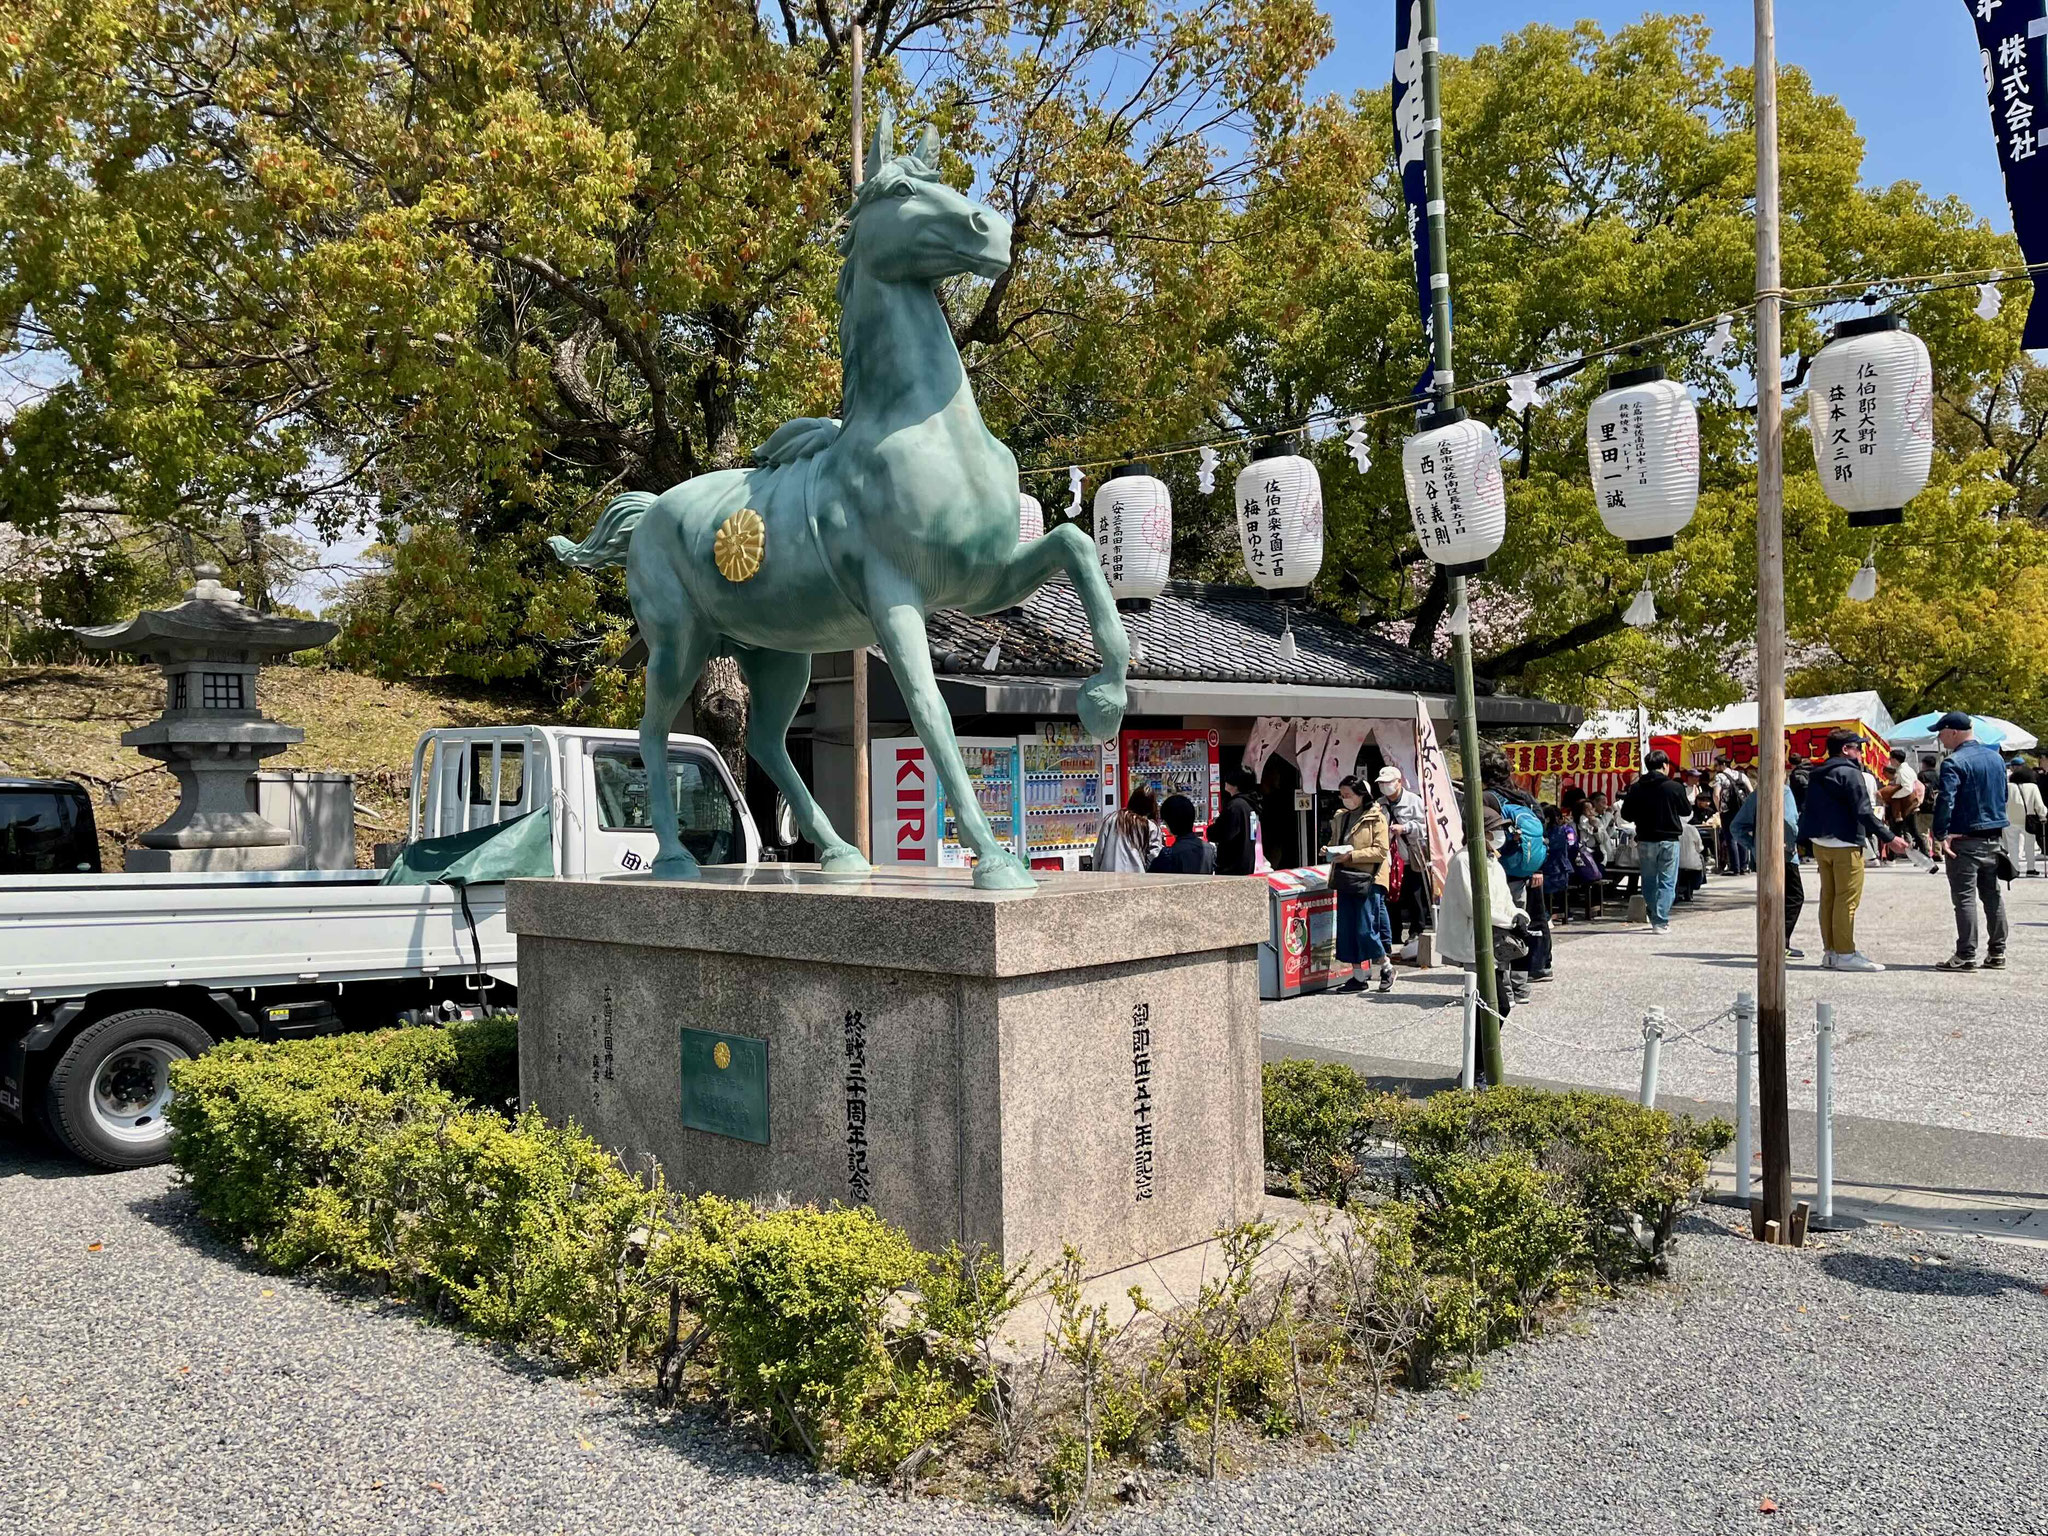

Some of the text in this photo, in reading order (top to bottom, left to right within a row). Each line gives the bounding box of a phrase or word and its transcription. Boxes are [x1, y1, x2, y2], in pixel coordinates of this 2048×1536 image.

[1998, 34, 2036, 162] 株式会社
[1619, 403, 1630, 434] 鉄板焼き
[1829, 384, 1853, 483] 益本久三郎
[1856, 362, 1878, 455] 佐伯郡大野町
[1600, 422, 1627, 508] 里田一誠
[1112, 501, 1124, 582] 安芸高田市甲田町
[1243, 498, 1267, 576] 梅田ゆみこ
[844, 1010, 871, 1202] 終戦三十周年記念
[1132, 1003, 1154, 1202] 御即位五十年記念
